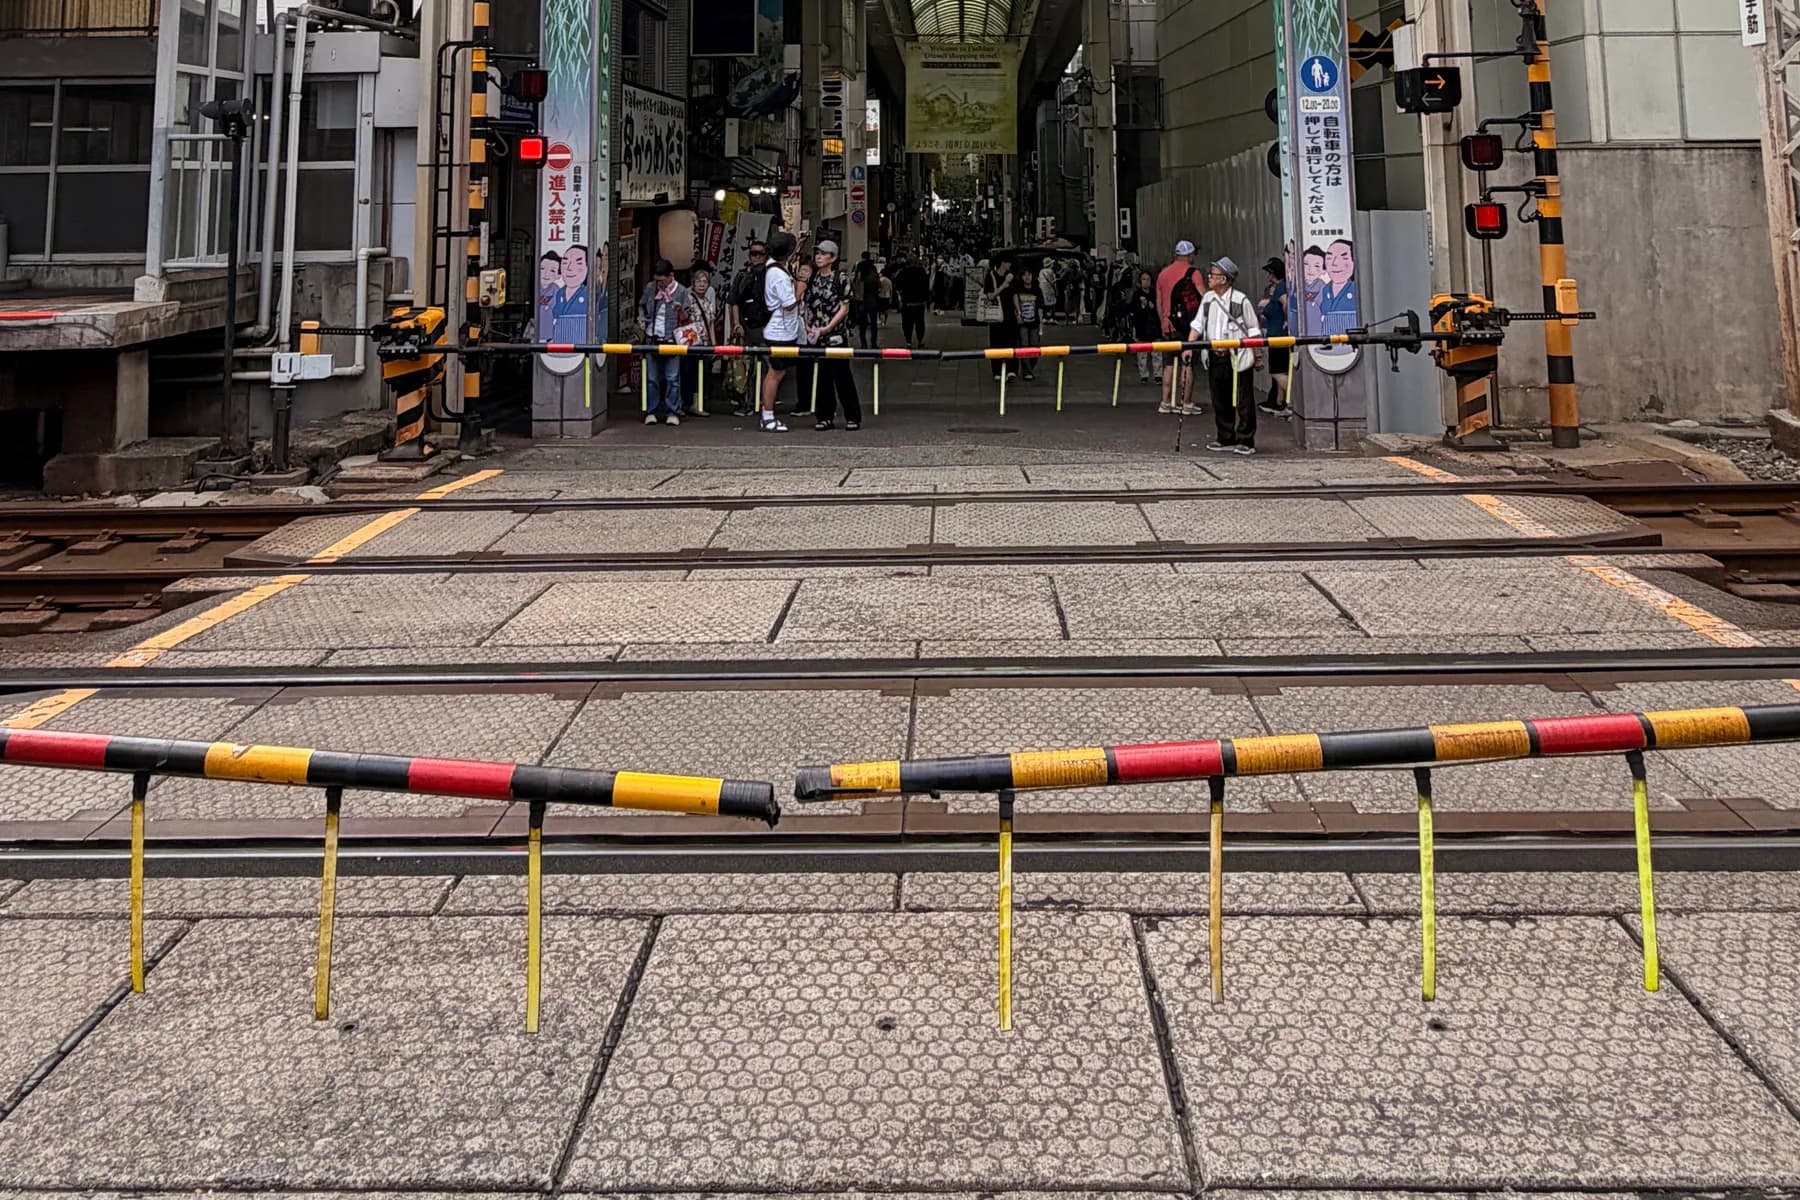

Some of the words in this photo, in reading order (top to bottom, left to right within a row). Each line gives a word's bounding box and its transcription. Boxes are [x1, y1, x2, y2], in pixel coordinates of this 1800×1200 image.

[1304, 115, 1325, 224] 押して通行してください
[1323, 116, 1342, 186] 自転車の方は
[548, 175, 566, 241] 進入禁止
[572, 165, 581, 242] 自動車・バイク終日
